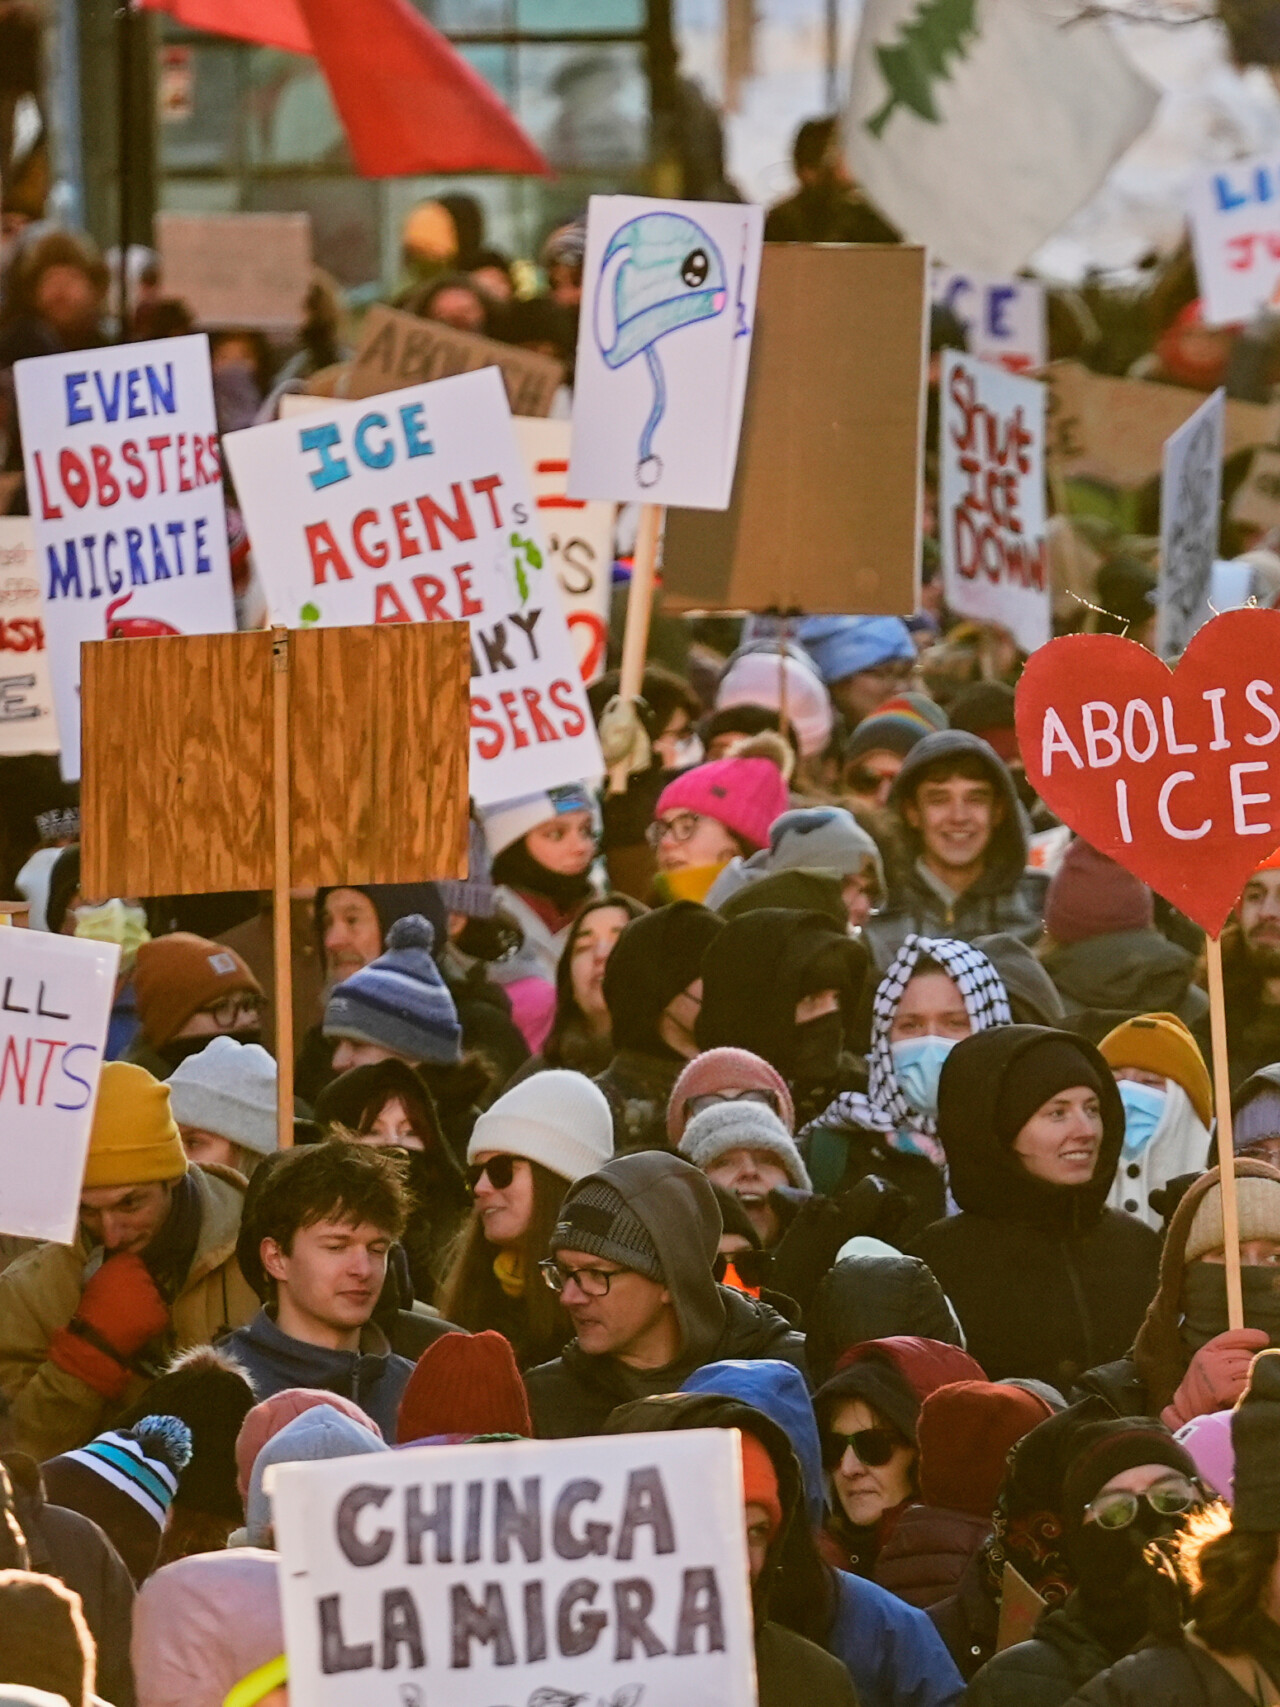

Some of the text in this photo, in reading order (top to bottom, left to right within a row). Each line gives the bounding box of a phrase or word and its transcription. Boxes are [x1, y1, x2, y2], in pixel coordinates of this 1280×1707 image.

[64, 363, 177, 426] EVEN
[34, 432, 222, 520] LOBSTERS
[300, 401, 435, 491] ICE
[958, 456, 1021, 534] ICE
[46, 517, 211, 601] MIGRATE
[373, 563, 485, 623] ARE
[469, 678, 585, 761] SERS
[1114, 761, 1272, 844] ICE
[2, 977, 71, 1021] LL
[0, 1035, 98, 1111] NTS
[335, 1465, 678, 1568] CHINGA
[317, 1566, 727, 1676] LA MIGRA
